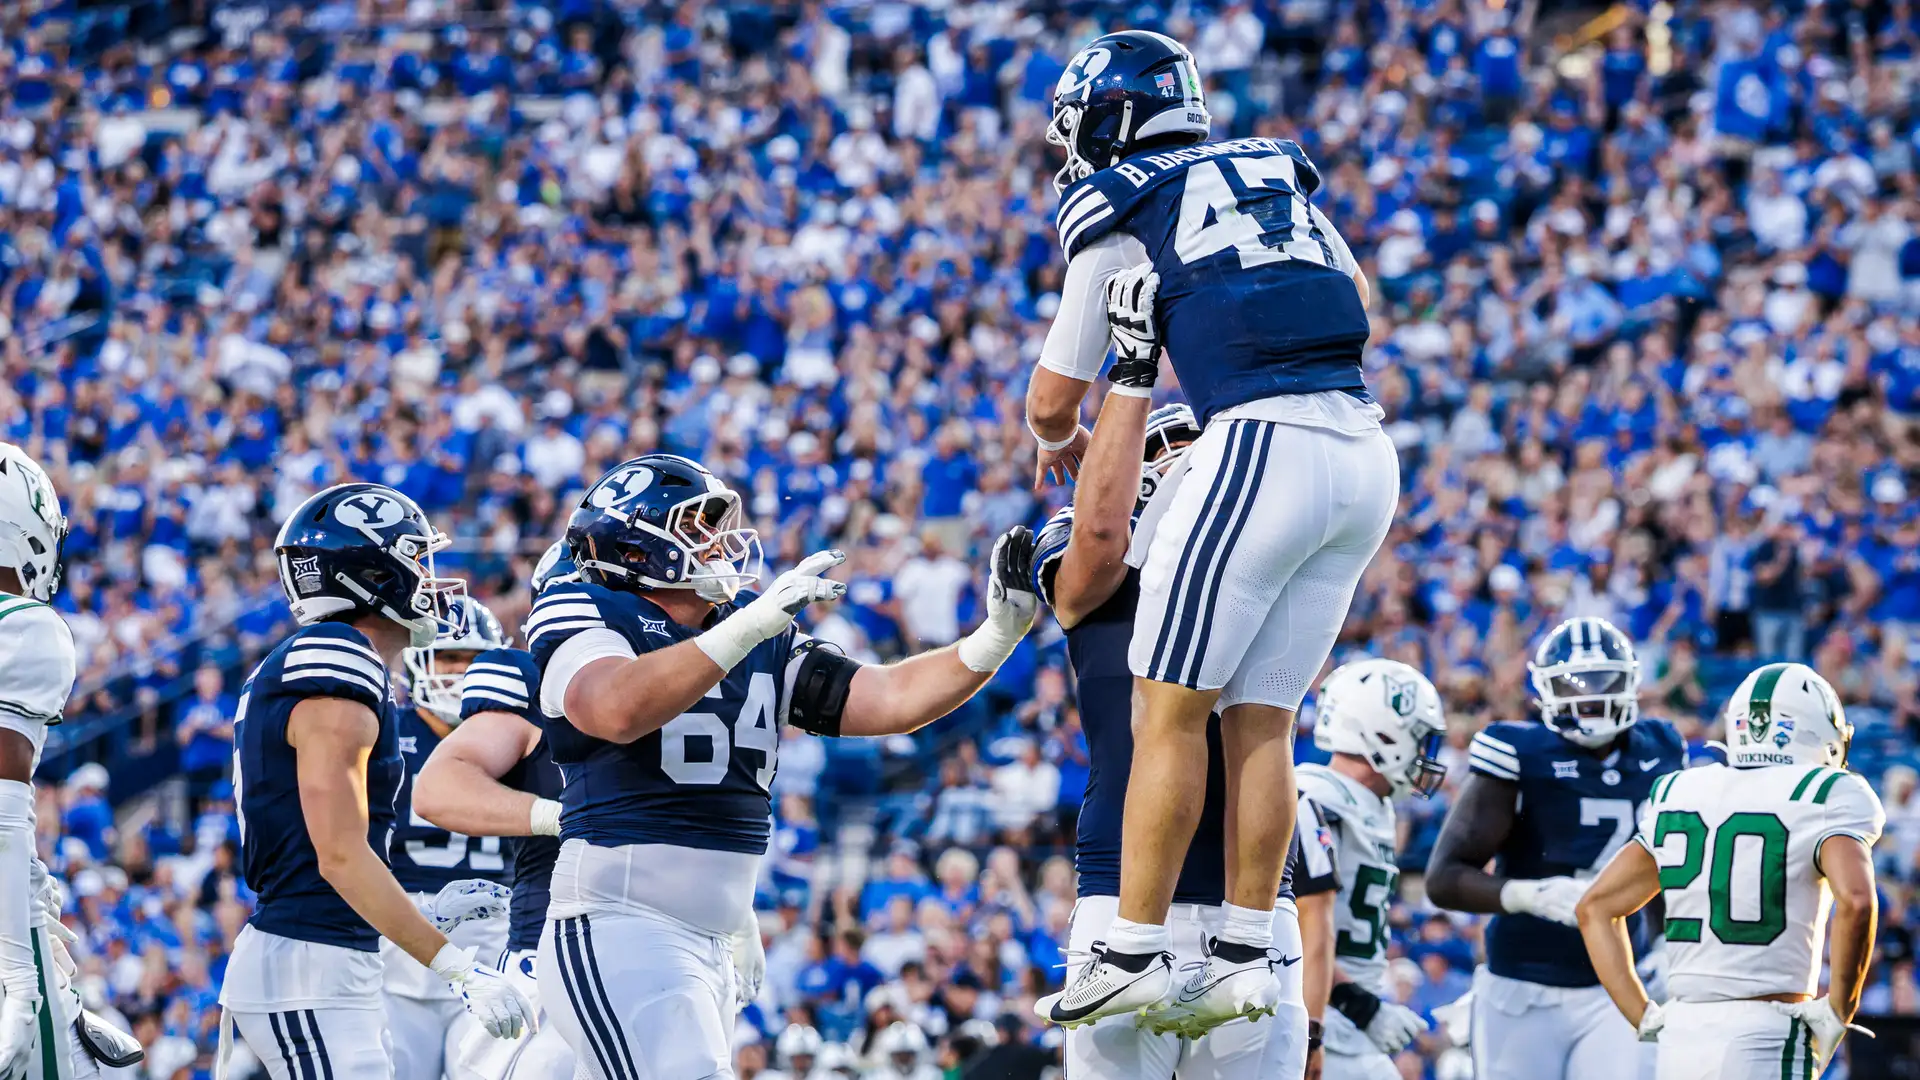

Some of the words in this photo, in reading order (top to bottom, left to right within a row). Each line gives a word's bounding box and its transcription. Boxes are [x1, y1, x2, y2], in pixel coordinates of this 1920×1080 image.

[1161, 86, 1175, 97] 47
[1114, 162, 1156, 189] B.
[1174, 154, 1328, 269] 47
[660, 672, 780, 794] 64
[1736, 753, 1794, 765] VIKINGS
[1575, 797, 1635, 879] 7
[1653, 810, 1790, 946] 20
